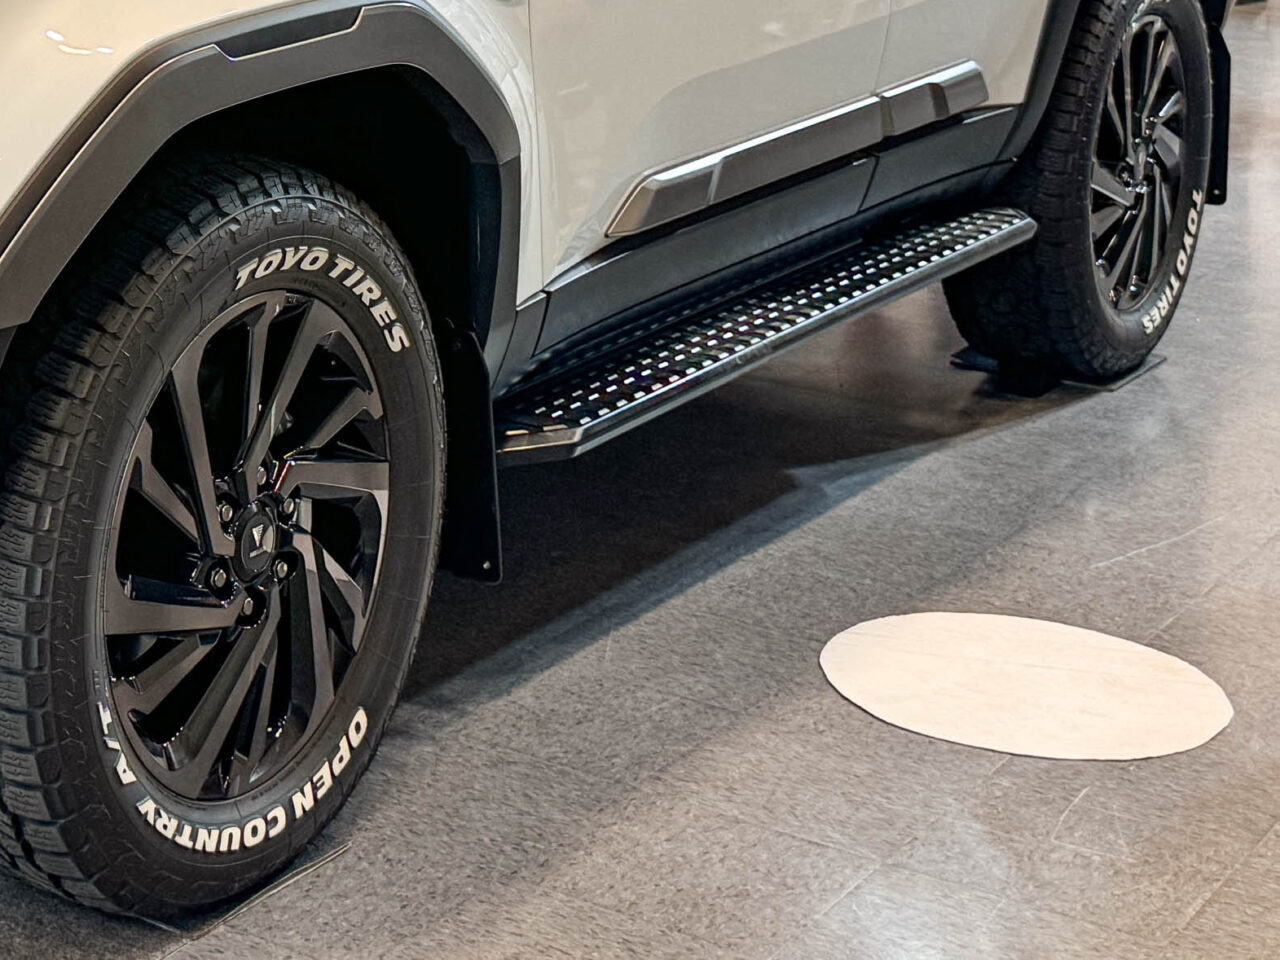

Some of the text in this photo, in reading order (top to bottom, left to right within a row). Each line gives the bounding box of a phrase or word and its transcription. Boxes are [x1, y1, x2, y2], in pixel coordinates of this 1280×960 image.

[235, 246, 411, 353] TOYO TIRES
[1140, 189, 1203, 334] TOYO TIRES
[291, 706, 368, 820] OPEN
[135, 796, 287, 853] COUNTRY
